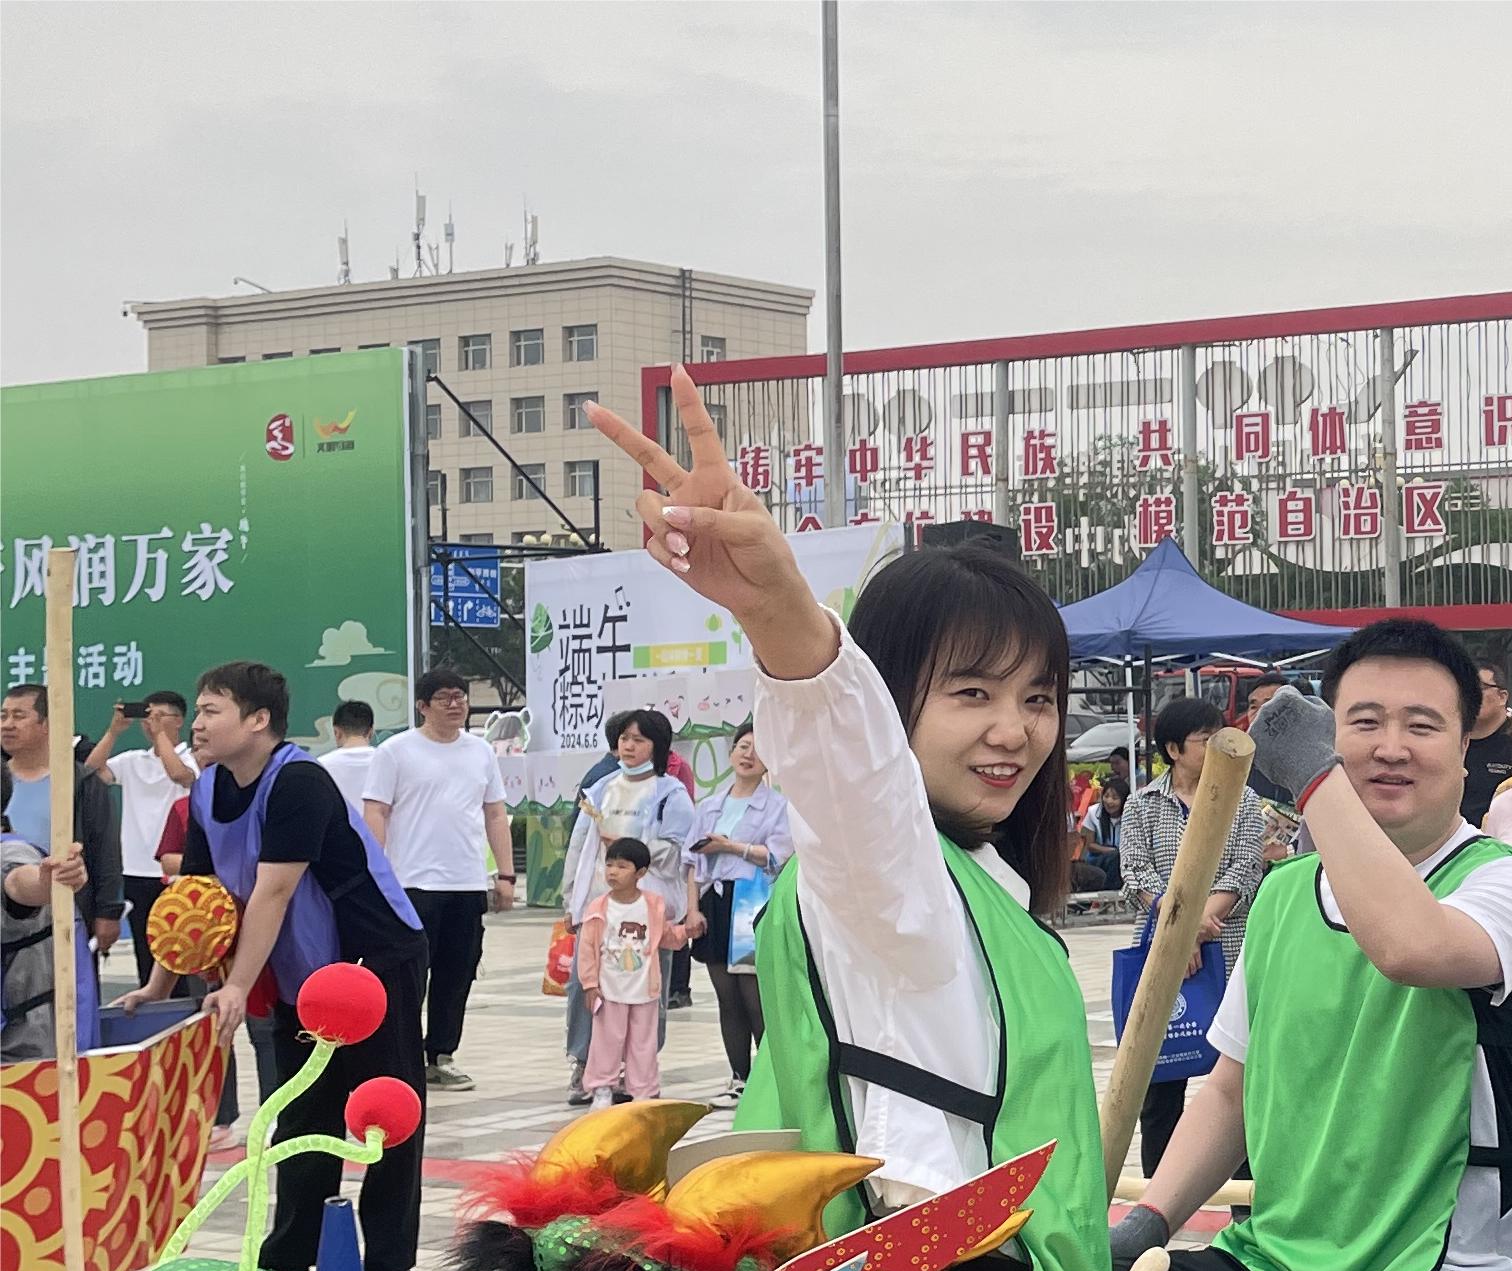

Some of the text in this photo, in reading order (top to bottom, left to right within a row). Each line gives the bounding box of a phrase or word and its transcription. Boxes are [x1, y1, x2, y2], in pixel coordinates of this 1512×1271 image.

[0, 523, 235, 609] 风润万家
[8, 640, 144, 688] 主活动
[557, 604, 631, 686] 端午
[561, 733, 598, 749] 2024.6.6
